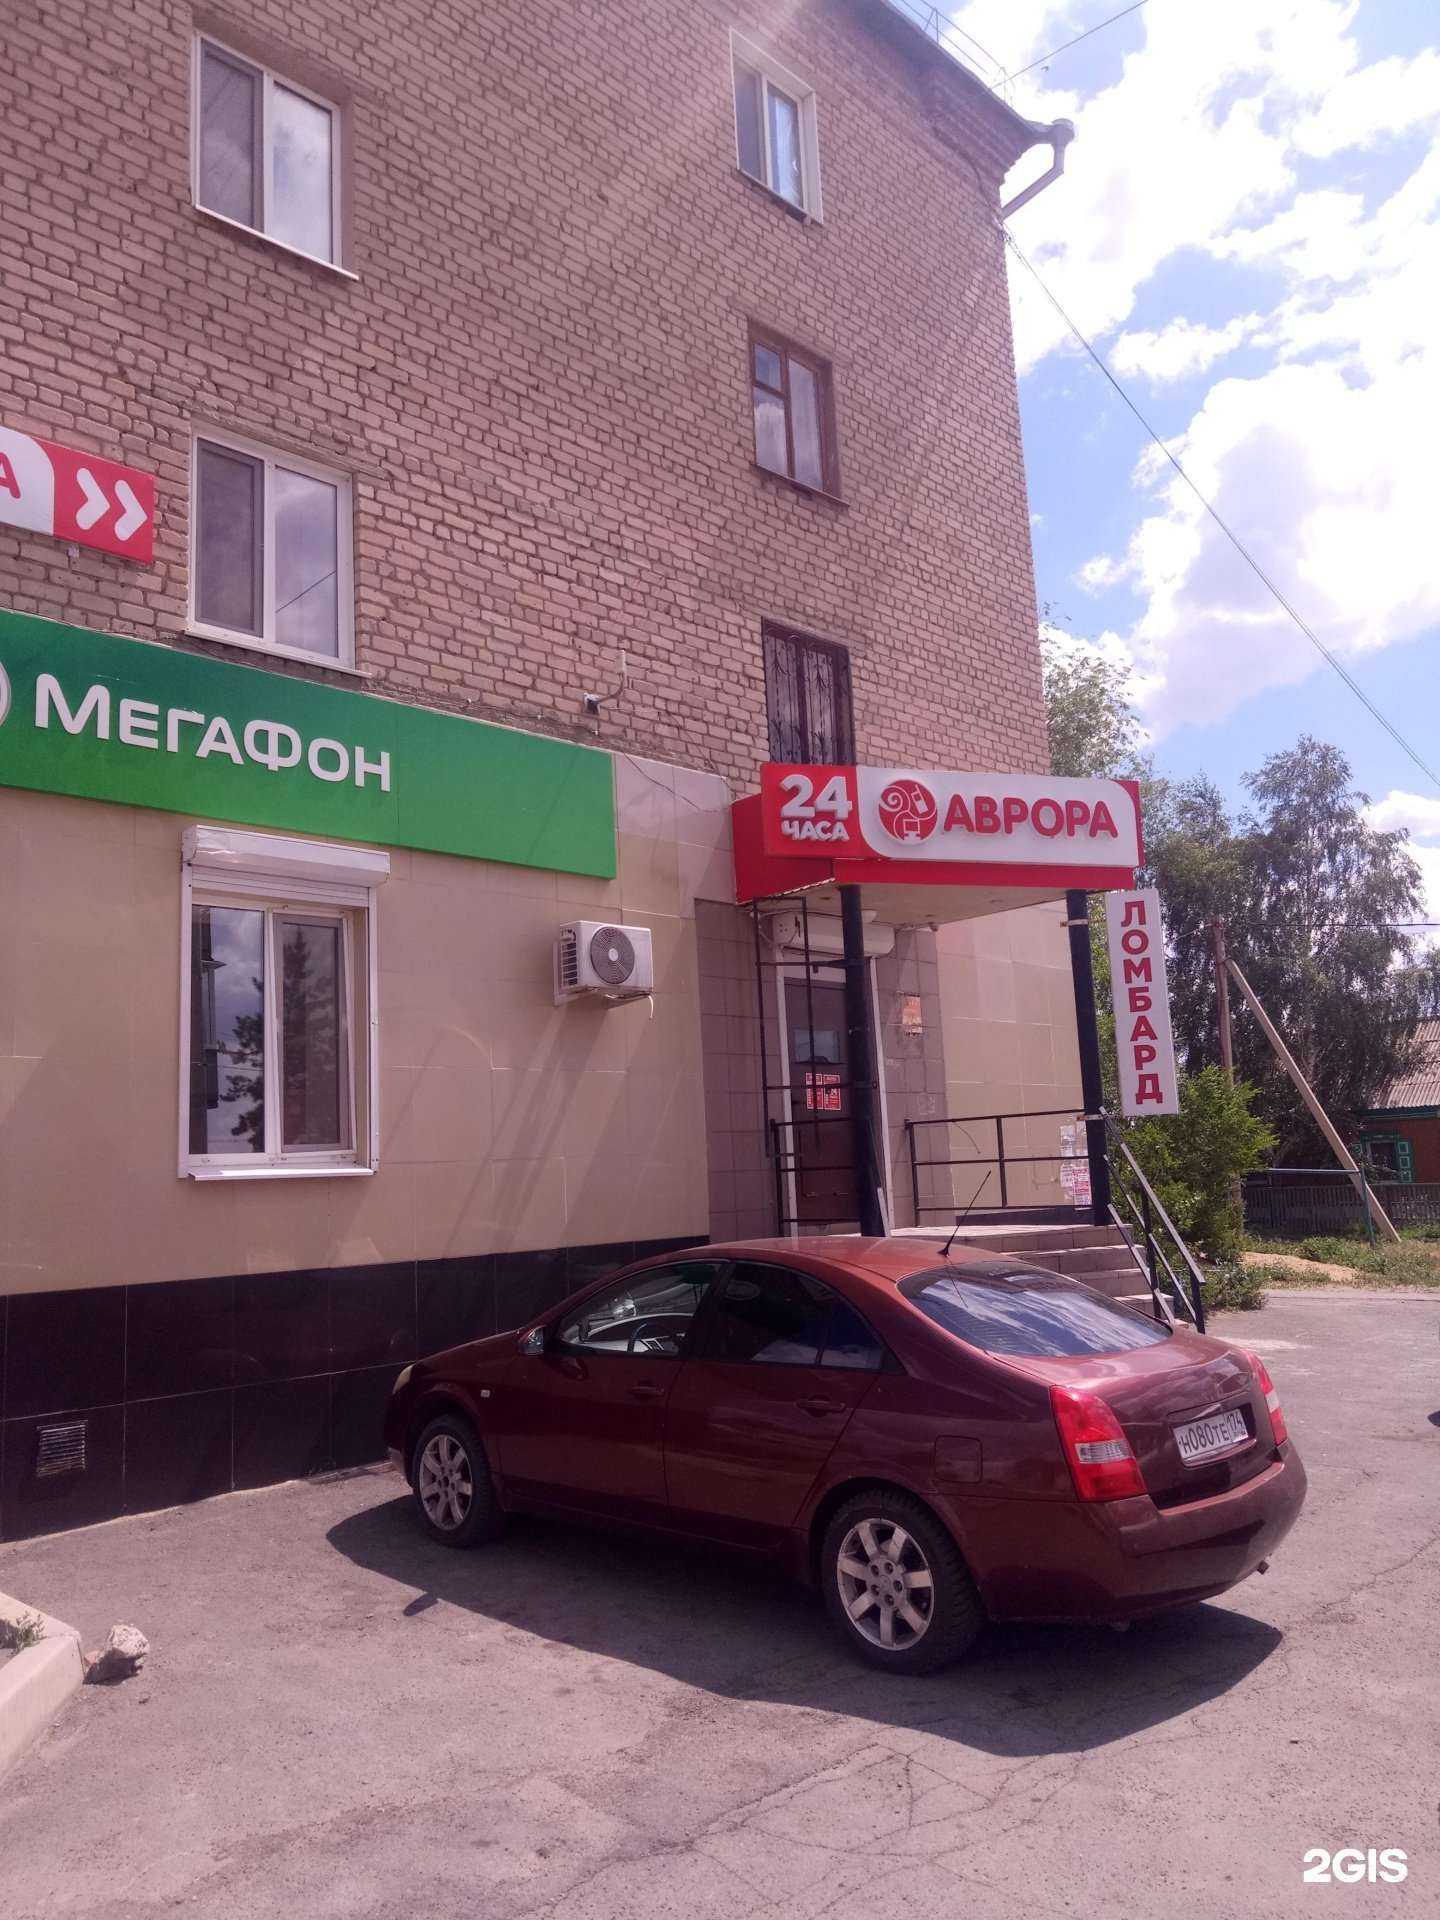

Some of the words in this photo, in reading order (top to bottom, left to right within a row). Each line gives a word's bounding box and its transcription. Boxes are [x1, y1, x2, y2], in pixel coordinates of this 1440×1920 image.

[35, 673, 391, 792] МЕГАФОН
[780, 774, 852, 819] 24
[943, 793, 1119, 839] АВРОРА
[781, 820, 850, 842] ЧАСА
[1121, 900, 1163, 1105] ЛОМБАРД
